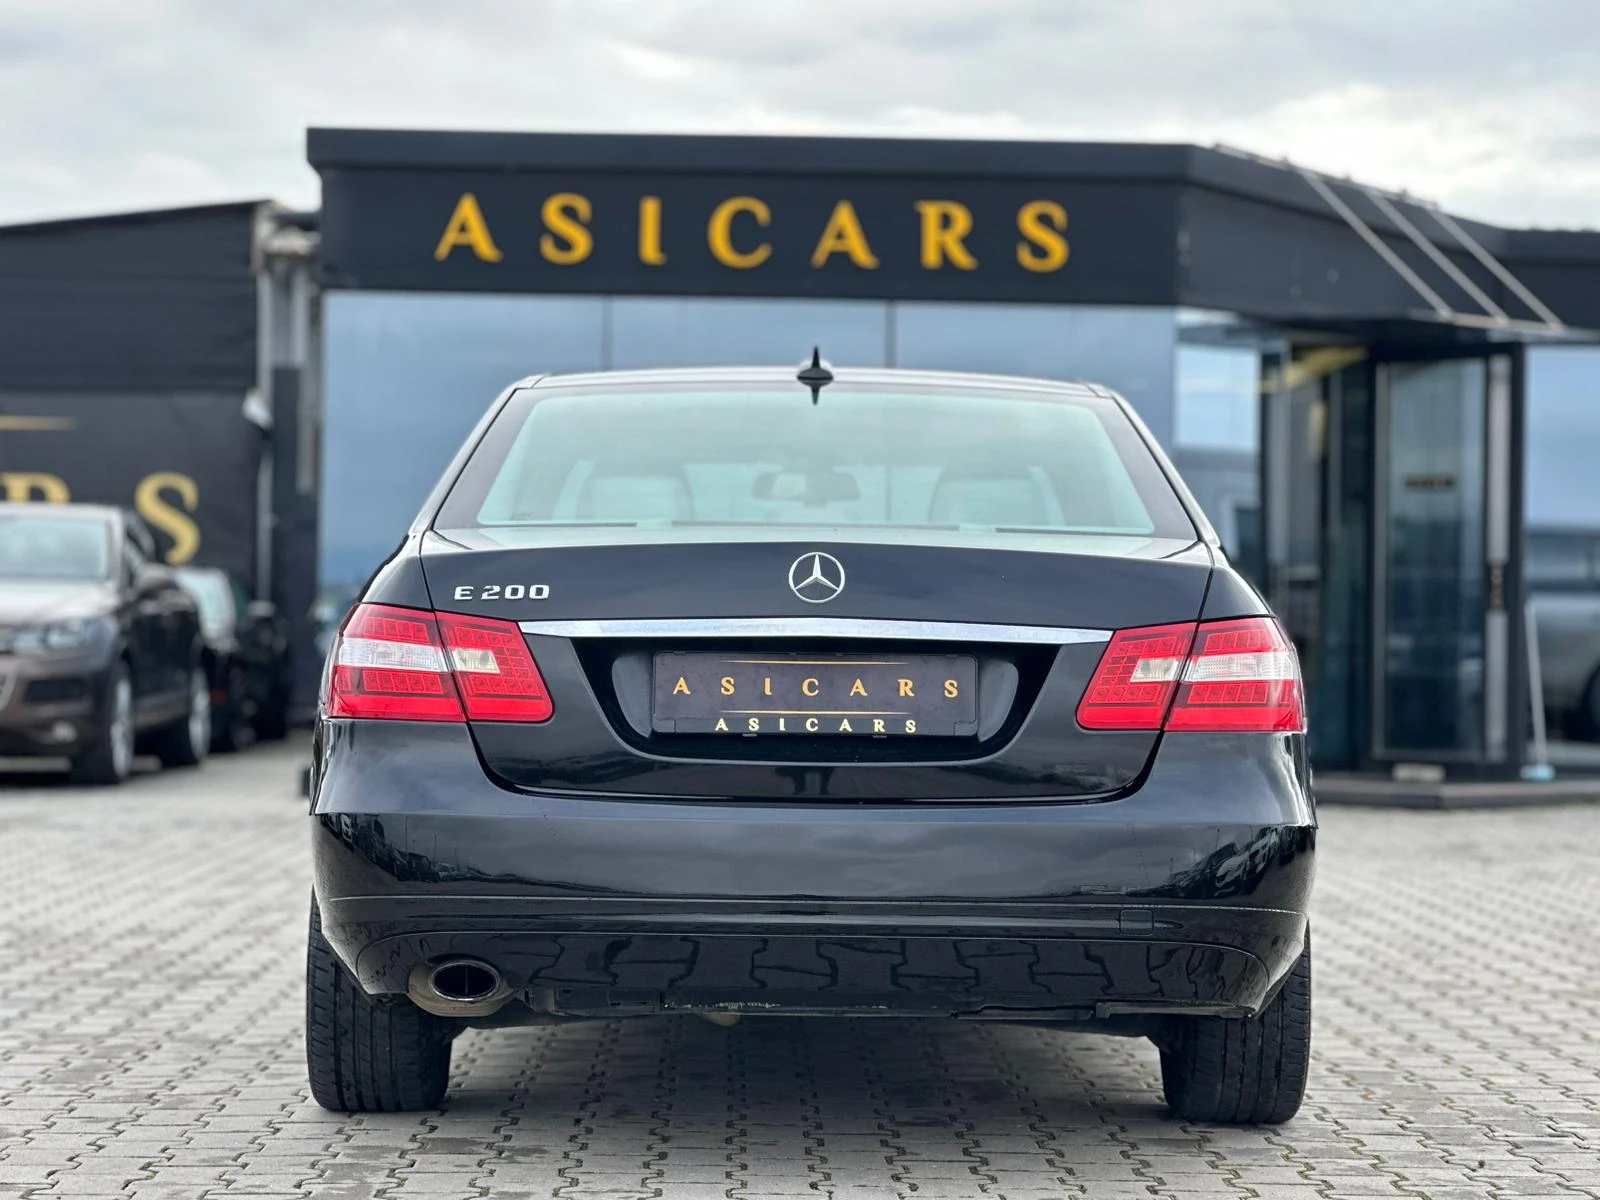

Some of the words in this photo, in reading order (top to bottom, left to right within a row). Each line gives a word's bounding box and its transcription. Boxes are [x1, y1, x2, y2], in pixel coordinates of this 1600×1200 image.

[434, 192, 1070, 273] ASICARS
[453, 585, 474, 601] E
[480, 584, 551, 601] 200
[673, 676, 960, 699] ASICARS
[714, 717, 917, 734] ASICARS
